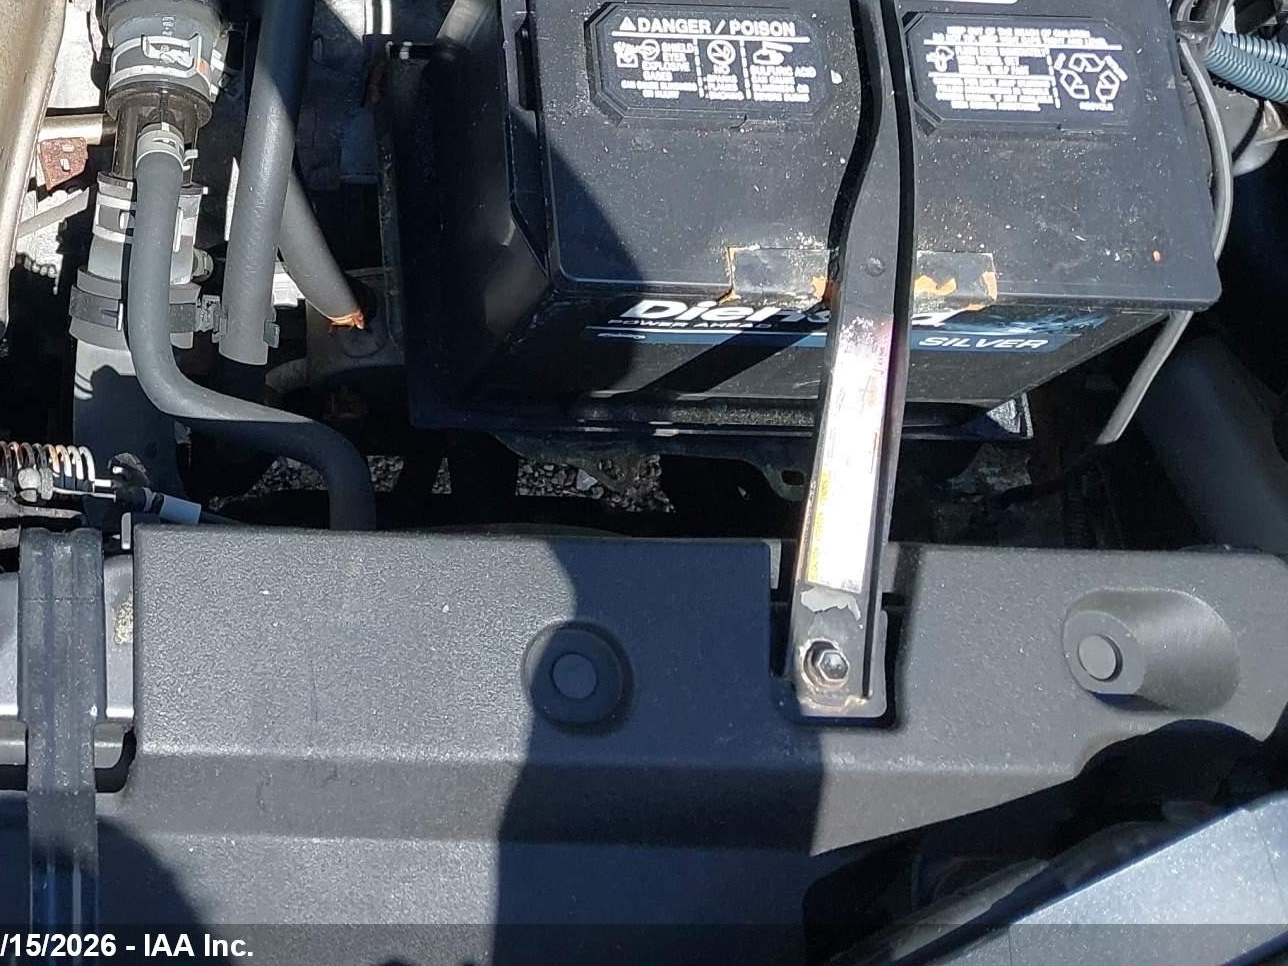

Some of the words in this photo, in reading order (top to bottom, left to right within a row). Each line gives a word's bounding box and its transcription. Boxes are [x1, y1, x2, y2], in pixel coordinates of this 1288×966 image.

[637, 17, 712, 34] DANGER
[714, 19, 726, 35] /
[729, 19, 796, 37] POISON
[608, 319, 688, 328] POWER
[693, 321, 773, 329] AHEAD
[918, 336, 1049, 349] SILVER
